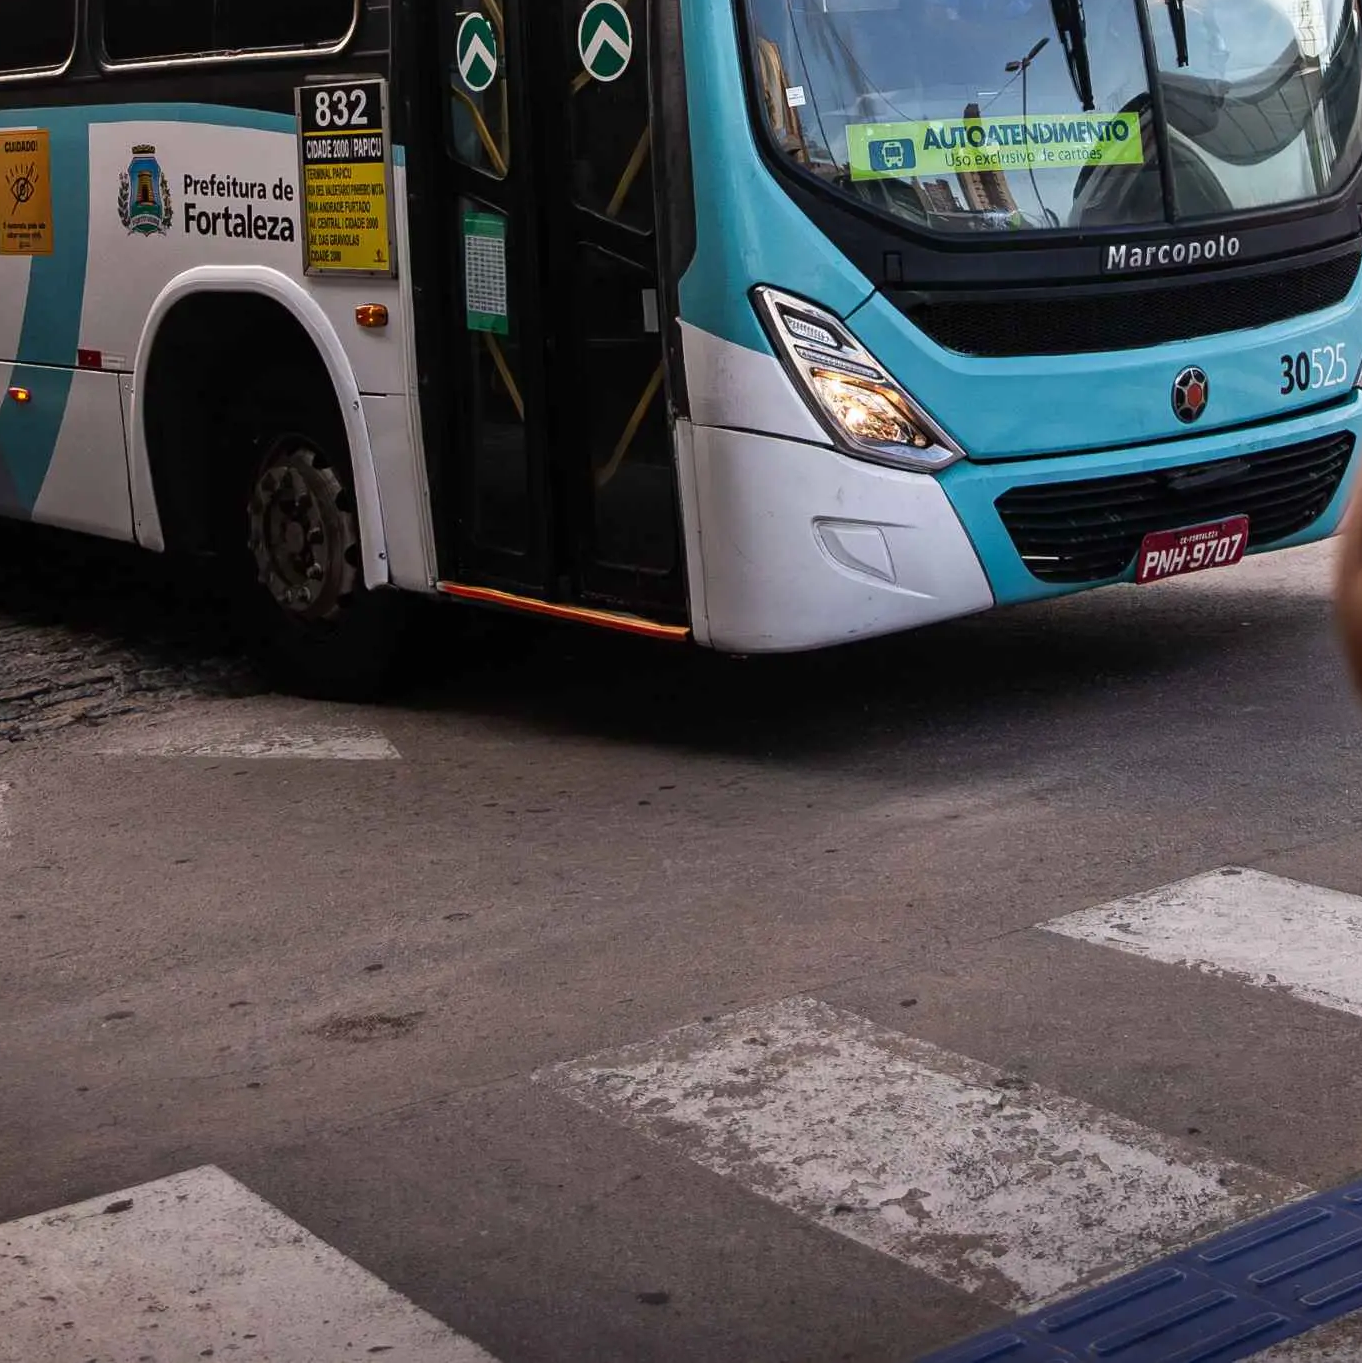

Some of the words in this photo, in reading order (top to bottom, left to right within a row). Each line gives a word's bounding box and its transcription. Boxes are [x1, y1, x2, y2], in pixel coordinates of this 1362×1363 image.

[315, 88, 368, 127] 832
[4, 140, 38, 153] CUIDADO!
[306, 139, 332, 159] CIDADE
[332, 138, 350, 158] 2000
[353, 137, 382, 157] PAPICU
[923, 118, 1129, 151] AUTOATENDIMENTO
[945, 151, 971, 167] Uso
[975, 149, 1036, 166] exclusivo
[1058, 146, 1103, 161] cartões
[332, 166, 352, 179] PAPICU
[183, 173, 267, 200] Prefeitura
[272, 177, 294, 201] de
[184, 202, 295, 242] Fortaleza
[317, 217, 342, 229] CENTRAL
[1107, 235, 1240, 270] Marcopolo
[1280, 342, 1347, 395] 30525
